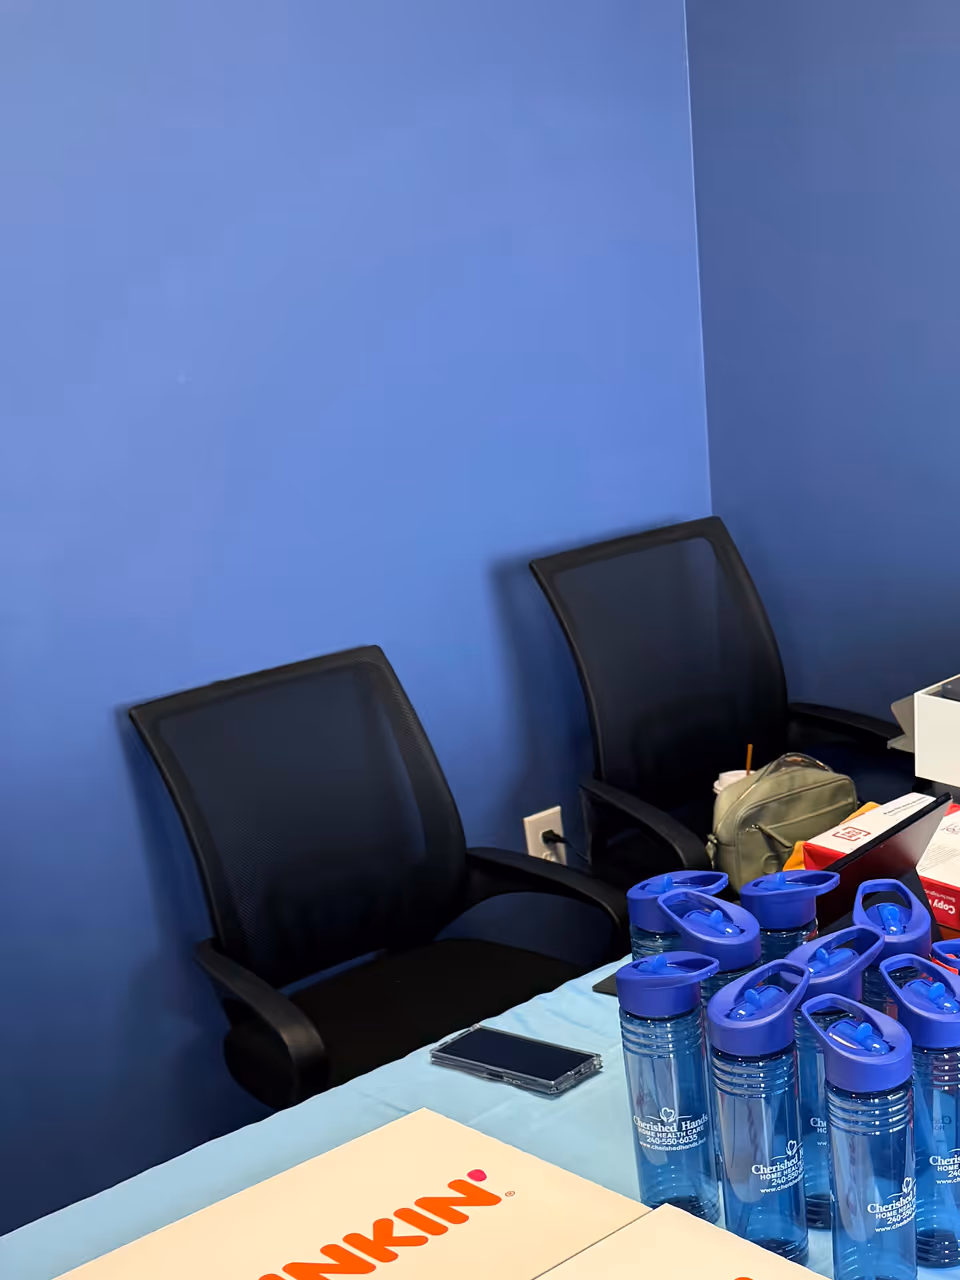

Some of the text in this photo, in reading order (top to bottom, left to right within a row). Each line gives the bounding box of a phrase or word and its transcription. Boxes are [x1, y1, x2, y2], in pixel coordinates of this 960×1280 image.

[933, 900, 956, 915] Copy
[633, 1113, 708, 1133] Cherished Hands
[638, 1125, 705, 1139] HOME HEALTH CARE
[646, 1134, 699, 1146] 240-550-6035
[751, 1153, 798, 1175] Cherished
[937, 1164, 959, 1172] HOME
[760, 1171, 782, 1181] HOME
[867, 1190, 913, 1214] Cherished
[875, 1209, 898, 1220] HOME
